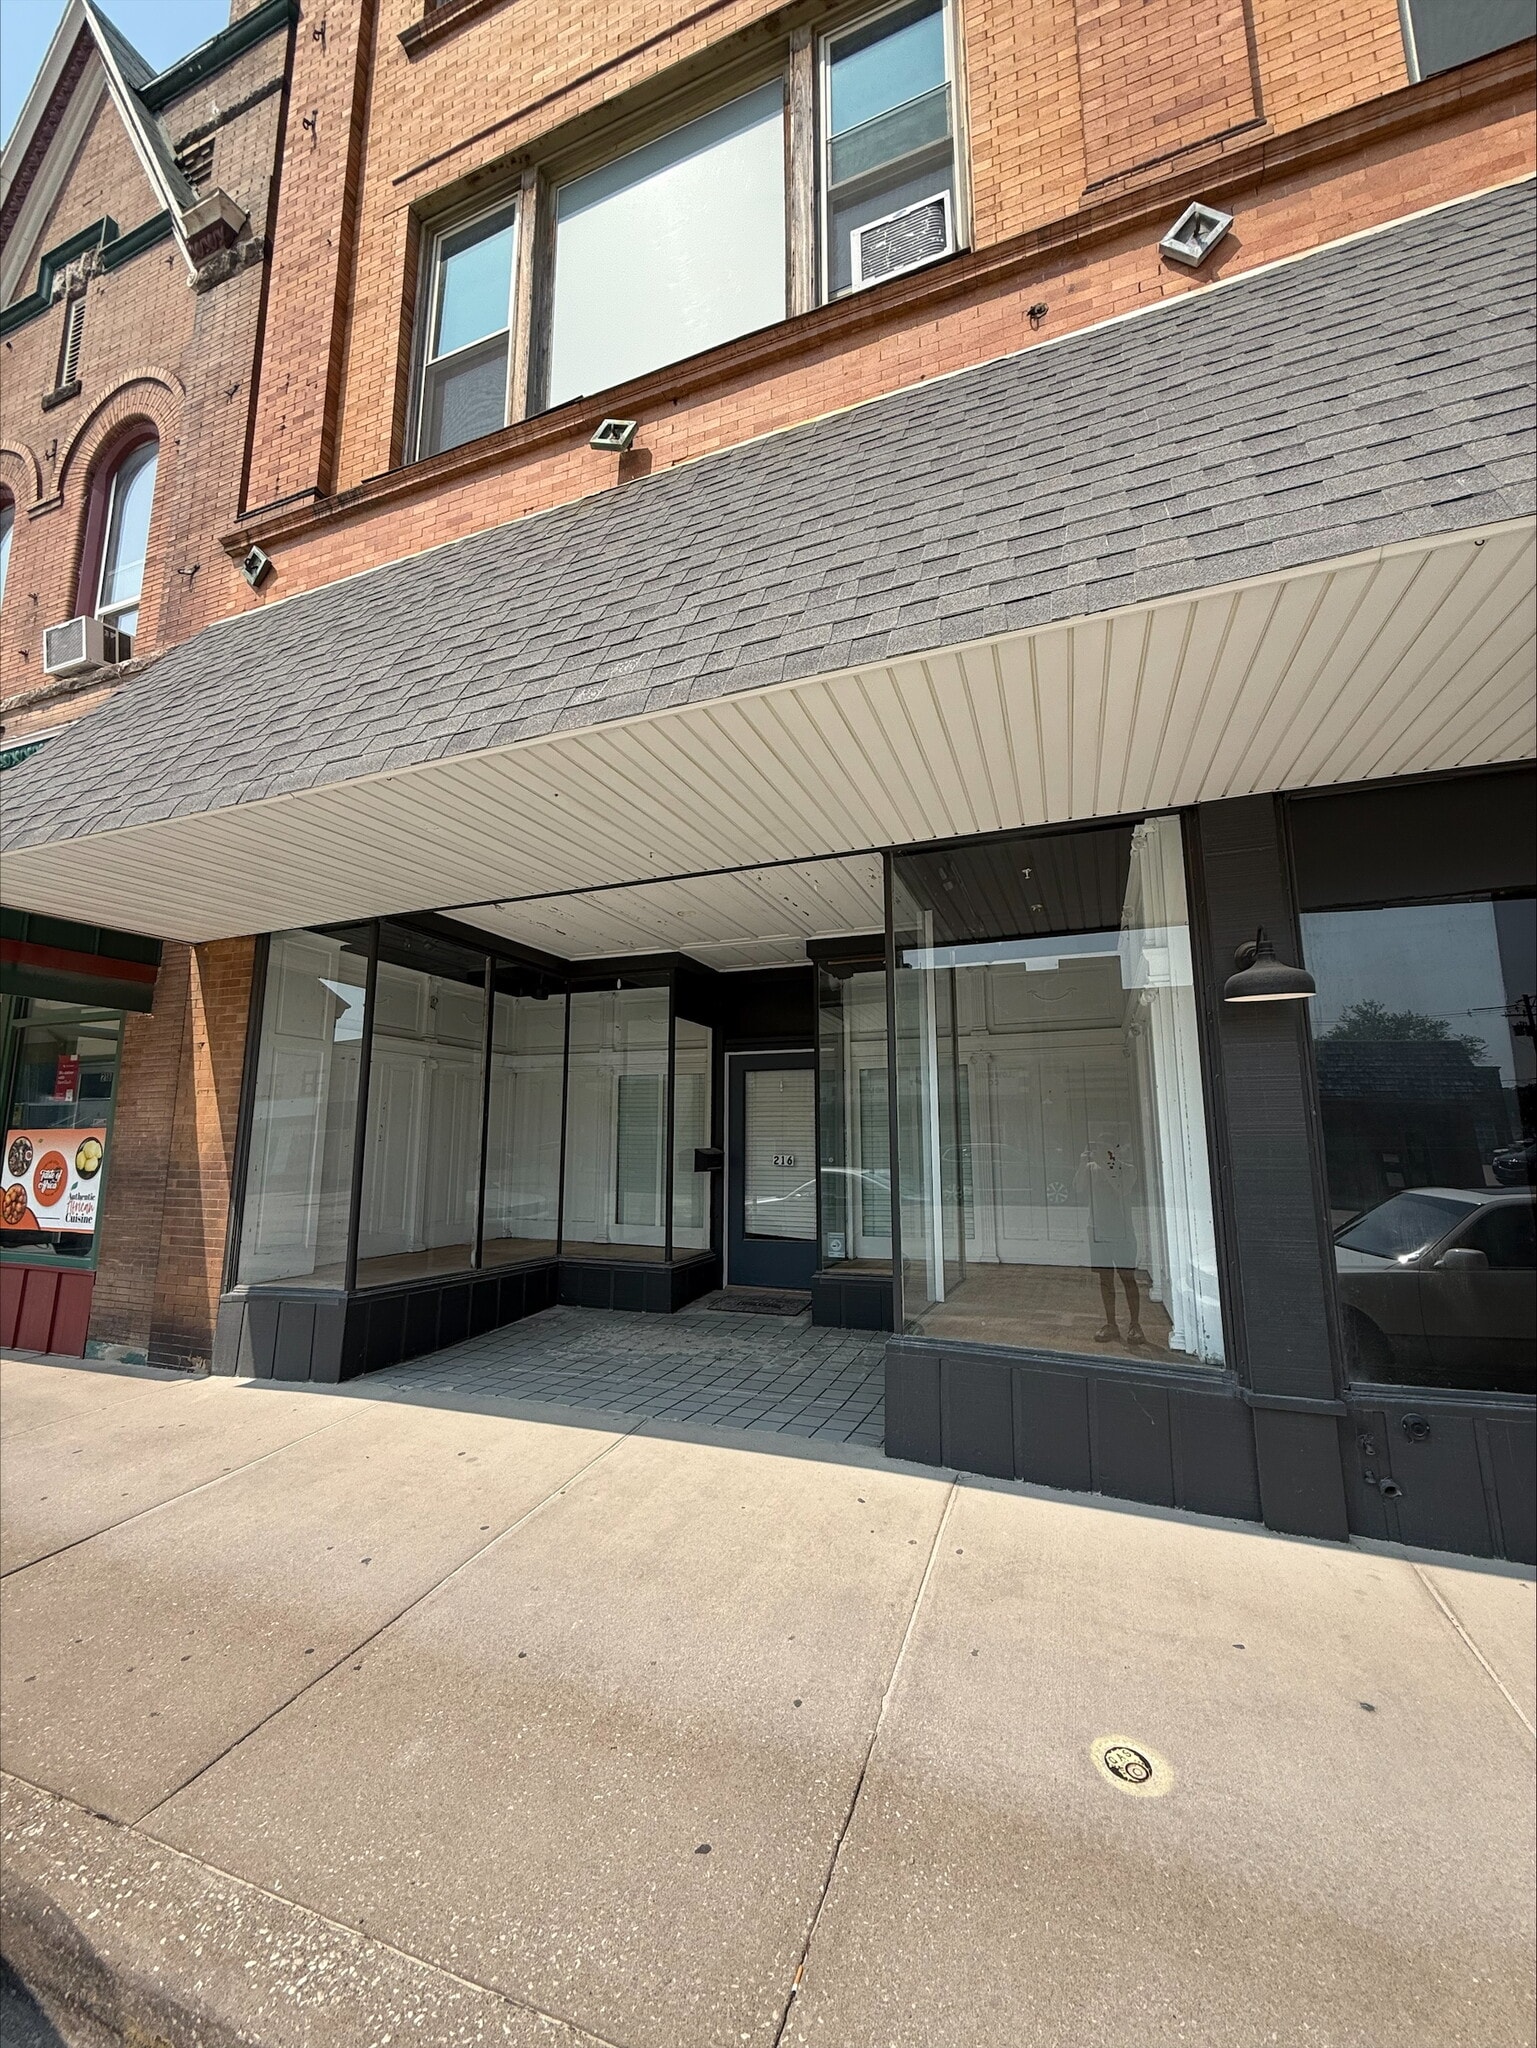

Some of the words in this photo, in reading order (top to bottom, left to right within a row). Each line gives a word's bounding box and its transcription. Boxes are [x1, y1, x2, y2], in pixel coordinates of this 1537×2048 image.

[773, 1155, 793, 1165] 216
[69, 1192, 95, 1200] Authentic
[65, 1213, 93, 1223] Cuisine
[1107, 1750, 1131, 1764] GAS
